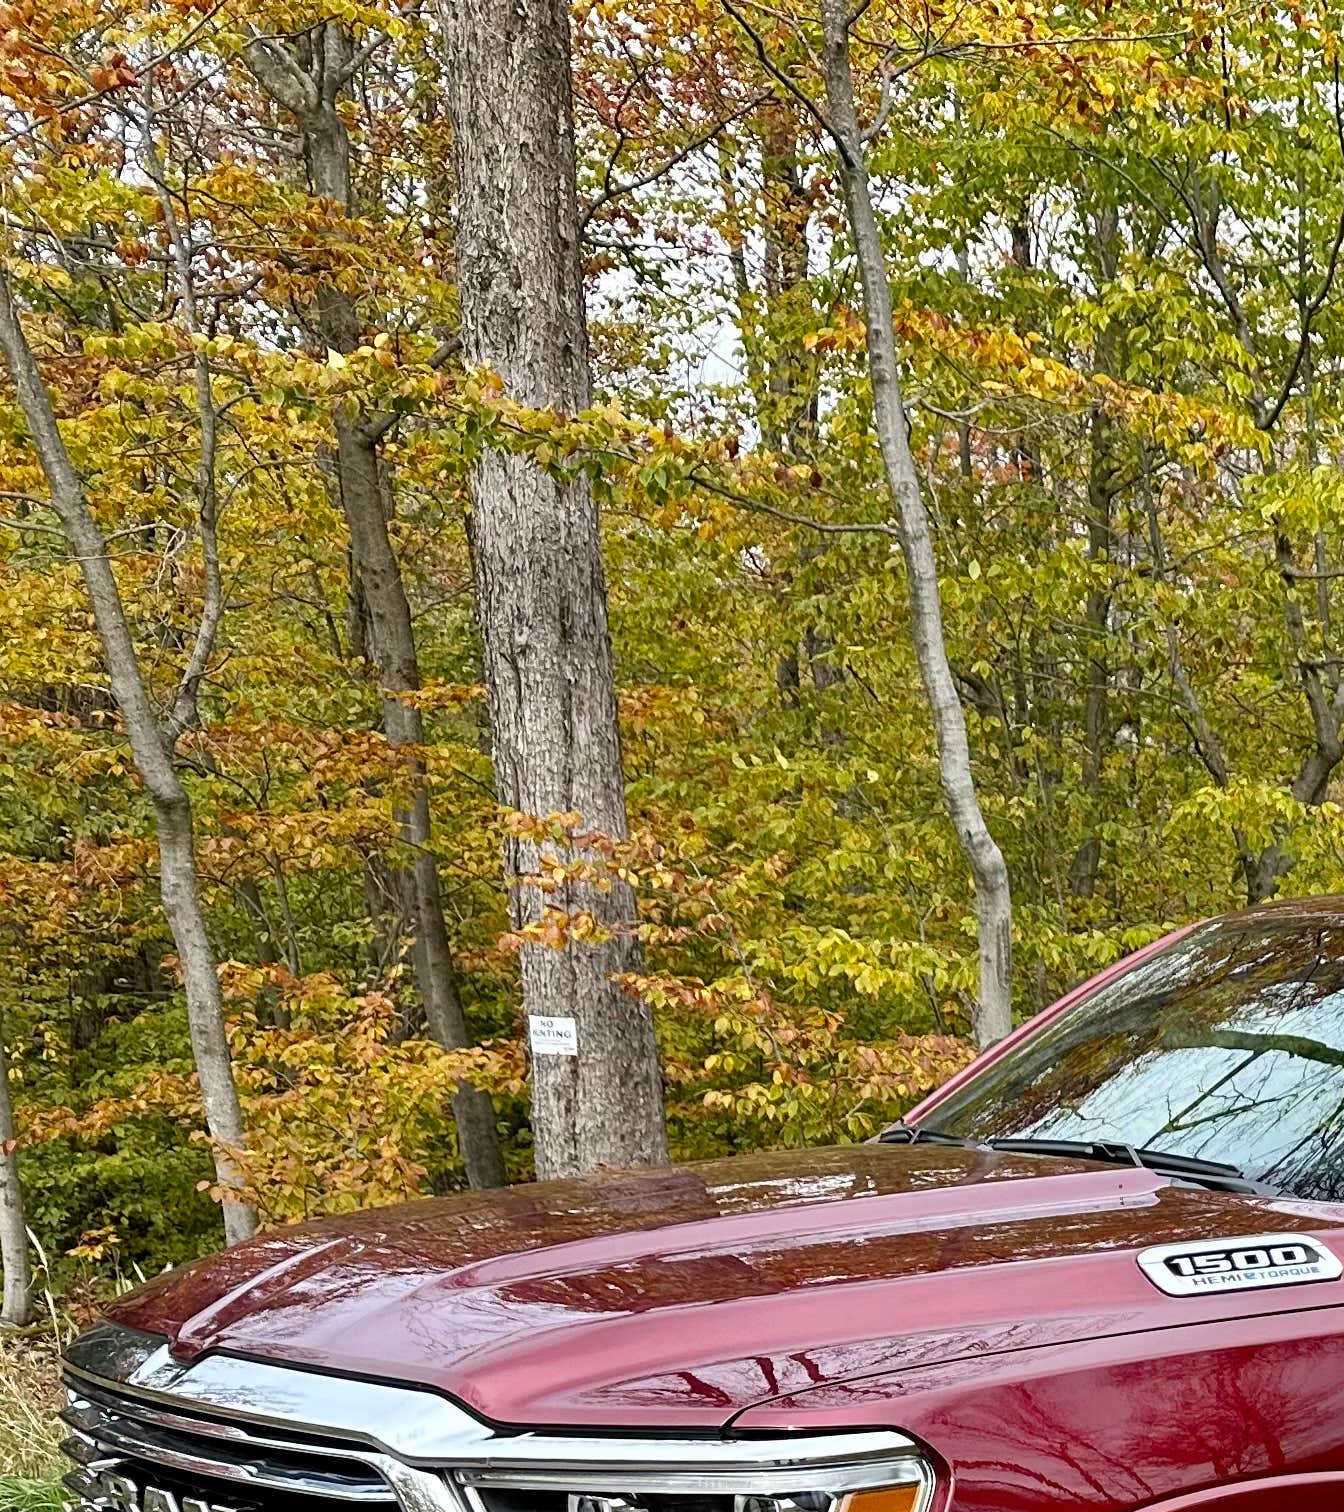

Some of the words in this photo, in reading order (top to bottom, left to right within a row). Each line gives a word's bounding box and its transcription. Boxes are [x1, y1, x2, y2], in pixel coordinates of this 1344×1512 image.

[540, 1020, 554, 1029] NO
[1169, 1246, 1308, 1276] 1500
[1193, 1273, 1241, 1286] HEMI
